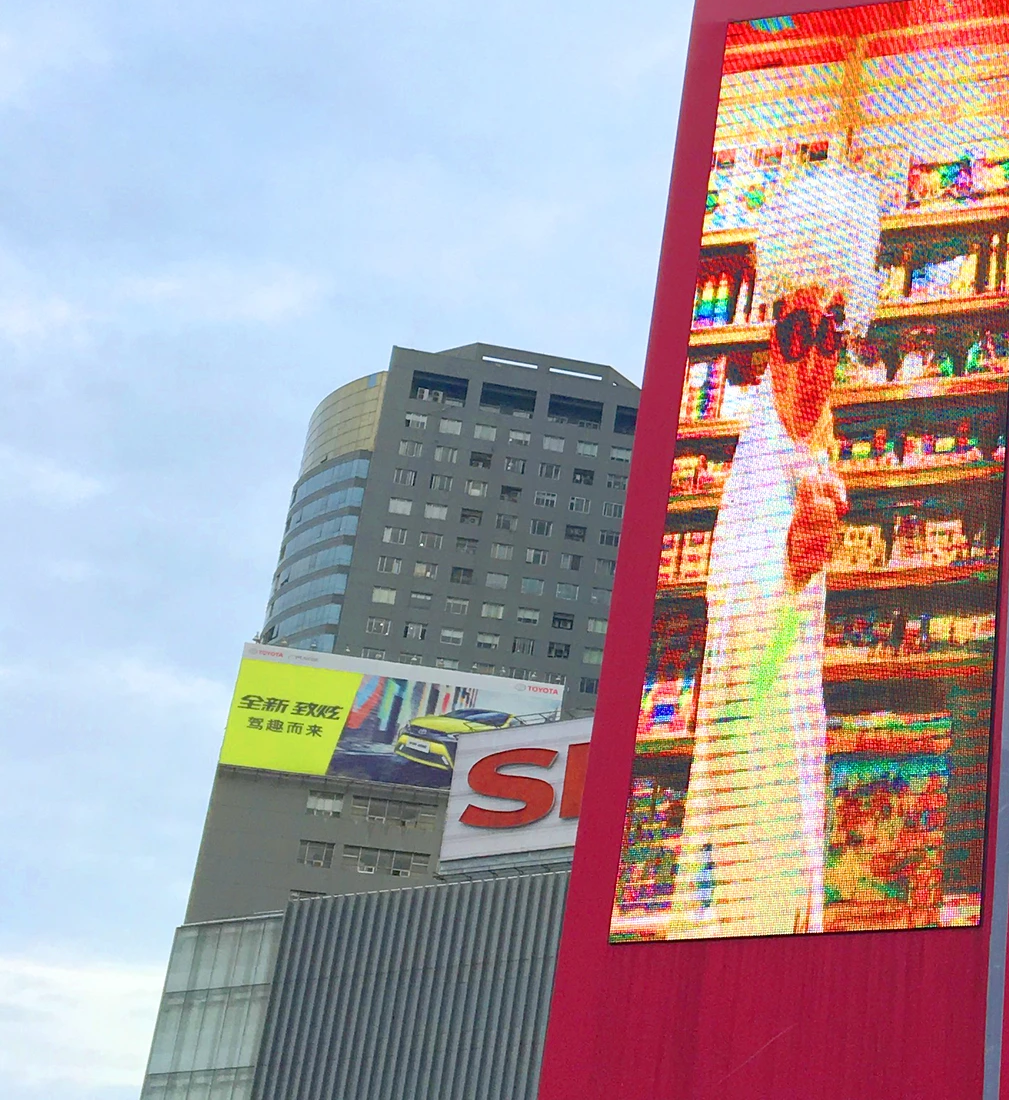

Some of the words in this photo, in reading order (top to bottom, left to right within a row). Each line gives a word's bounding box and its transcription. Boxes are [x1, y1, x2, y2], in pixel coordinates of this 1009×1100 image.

[259, 649, 284, 658] TOYOTA
[528, 685, 558, 695] TOYOTA
[246, 716, 323, 737] 驾趣而来
